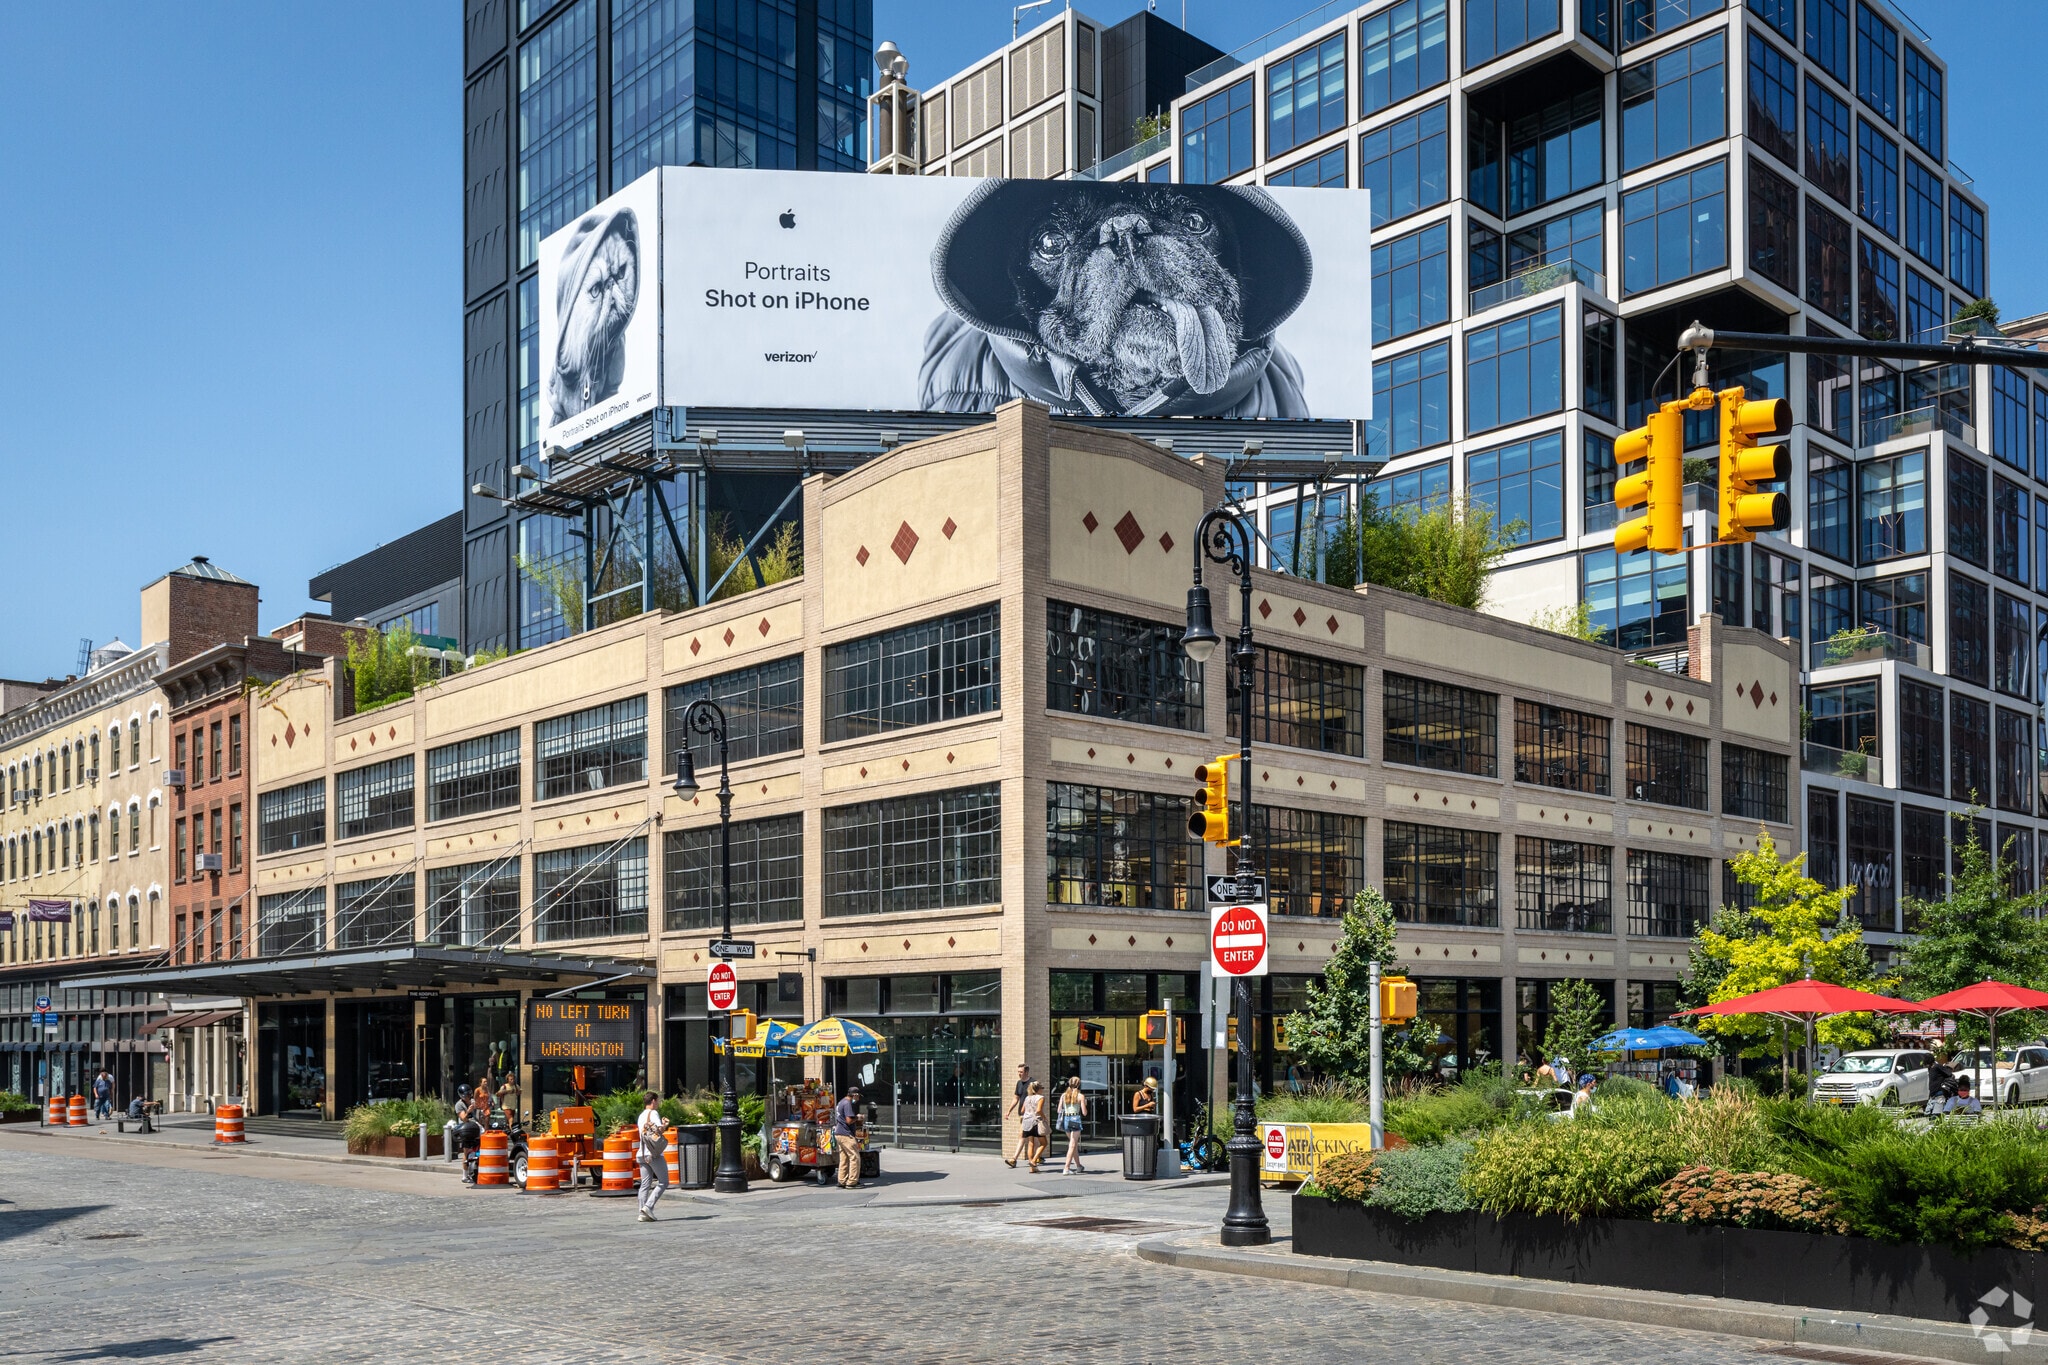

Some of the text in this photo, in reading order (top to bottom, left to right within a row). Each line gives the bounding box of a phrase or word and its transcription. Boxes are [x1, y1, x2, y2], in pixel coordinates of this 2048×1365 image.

[745, 261, 831, 282] Portraits
[705, 289, 870, 311] Shot on iPhone
[764, 351, 817, 363] verizon
[562, 400, 630, 440] Portraits Shot on iPhone
[1216, 884, 1234, 895] ONE
[1221, 919, 1257, 932] DO NOT
[715, 945, 752, 953] ONE WAY
[1223, 950, 1255, 962] ENTER
[712, 971, 731, 981] DO NOT
[713, 992, 731, 1001] ENTER
[536, 1004, 630, 1020] NO LEFT TURN
[575, 1023, 591, 1038] AT
[541, 1042, 624, 1057] WASHINGTON
[800, 1045, 845, 1053] SABRETT
